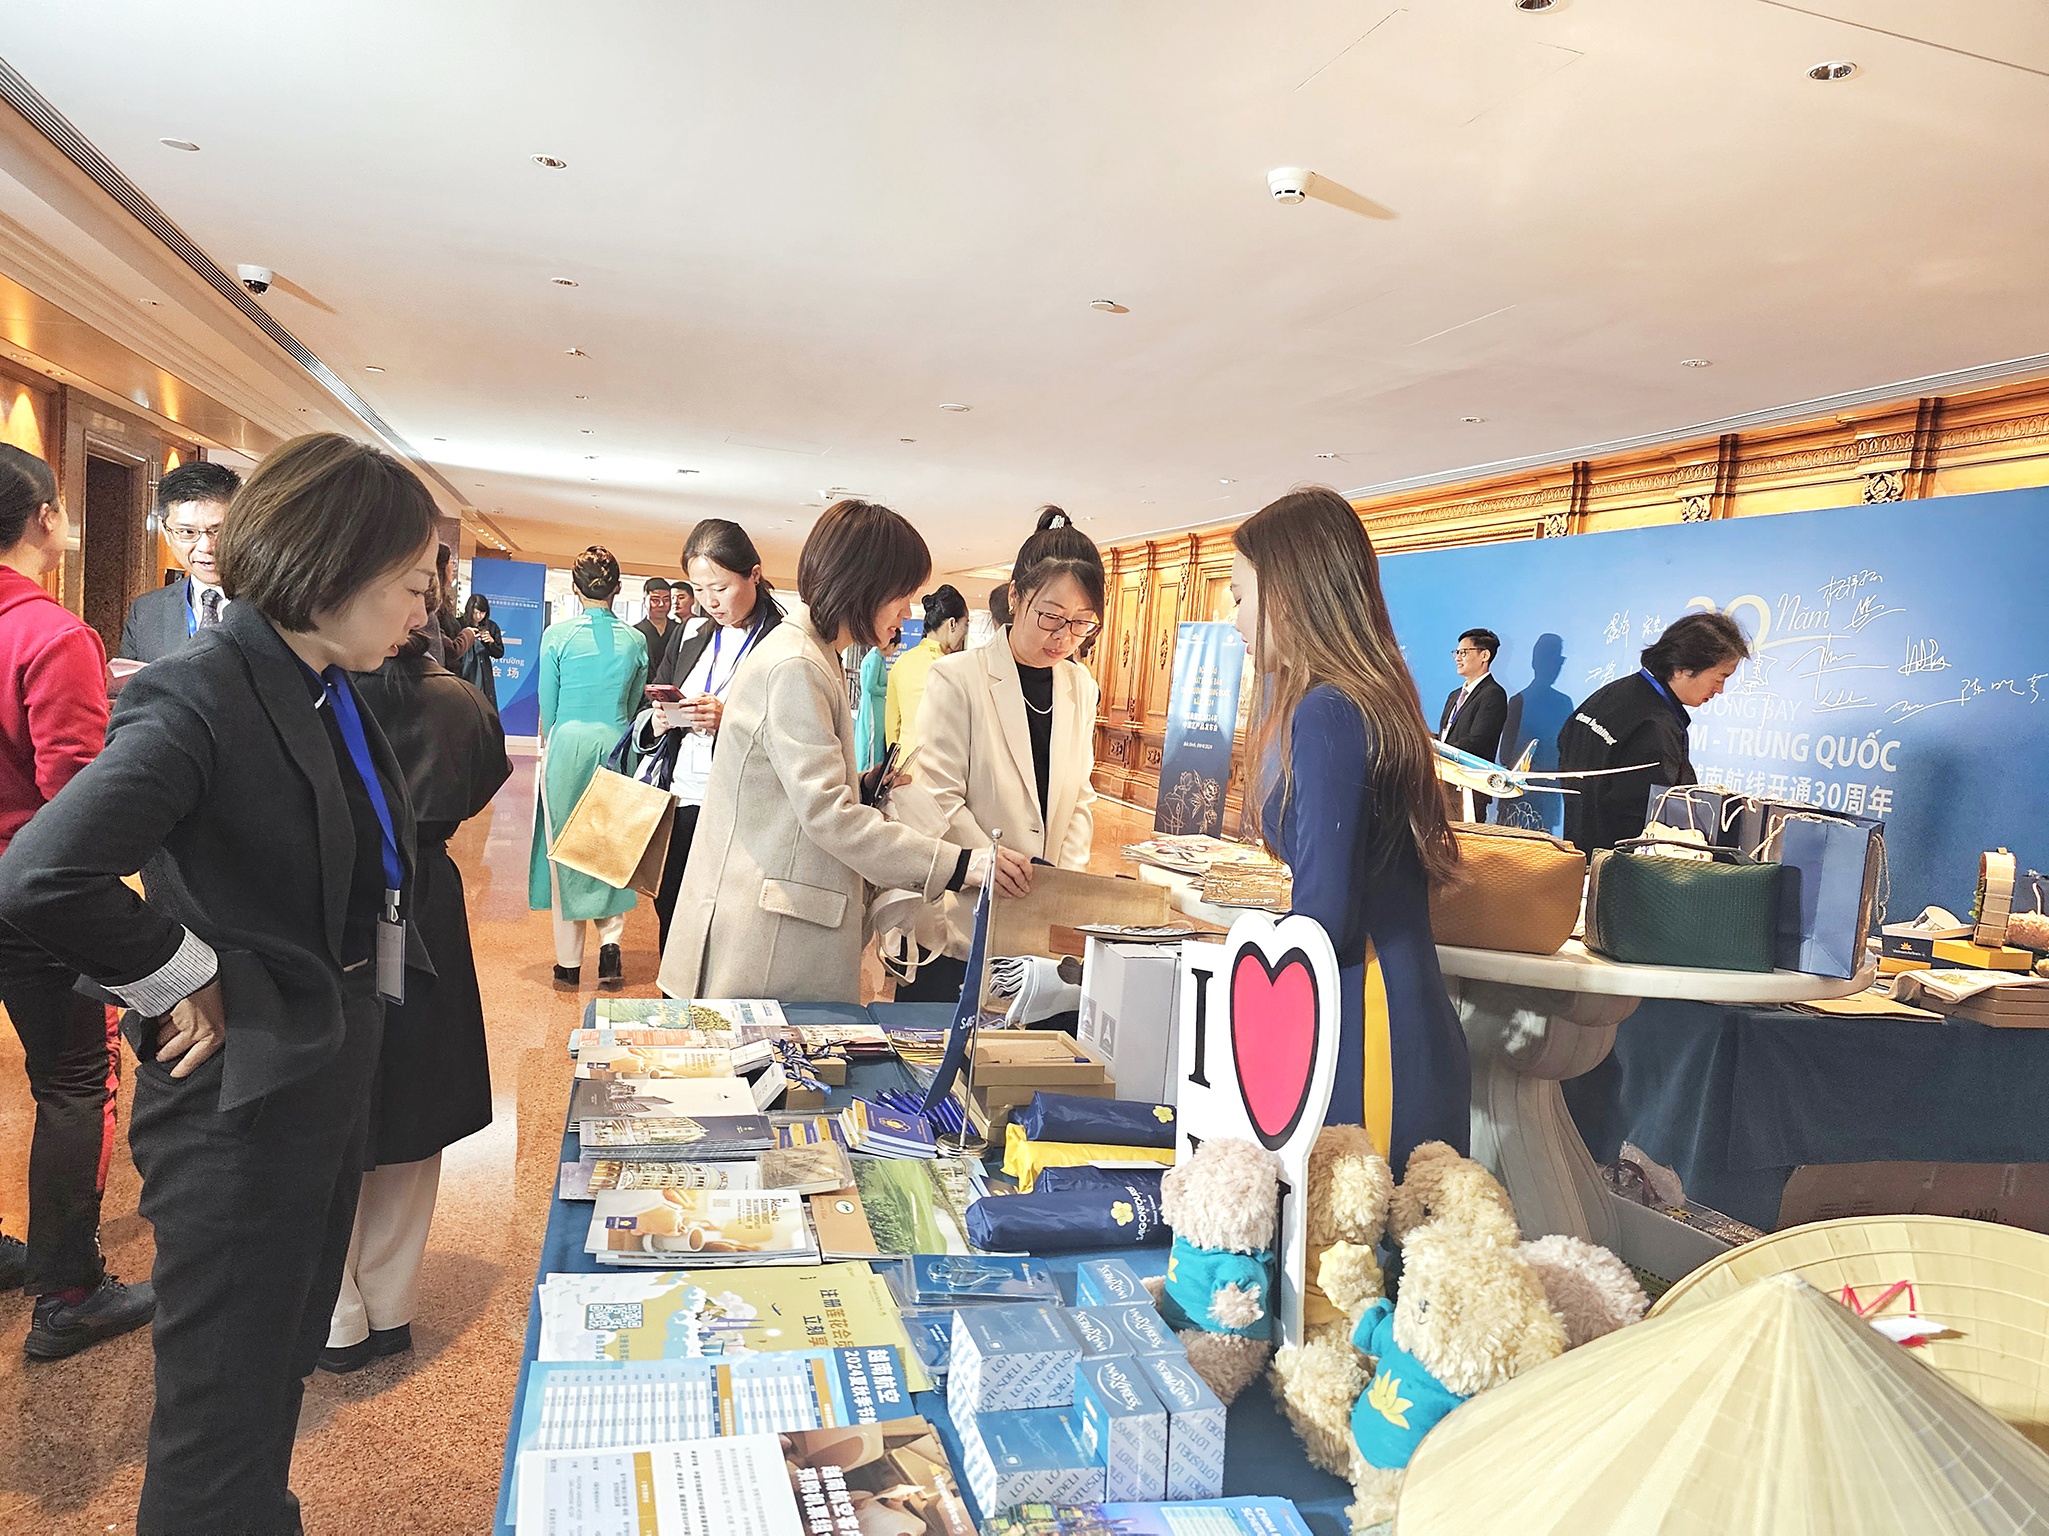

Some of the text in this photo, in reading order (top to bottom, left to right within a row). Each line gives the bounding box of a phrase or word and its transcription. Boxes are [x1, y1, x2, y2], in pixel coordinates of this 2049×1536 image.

[1776, 593, 1830, 632] Năm
[1727, 727, 1809, 762] TRUNG
[1815, 728, 1901, 772] QUỐC
[1189, 968, 1213, 1089] I
[866, 1349, 901, 1404] 越南航空
[797, 1467, 834, 1536] 预购机票组
